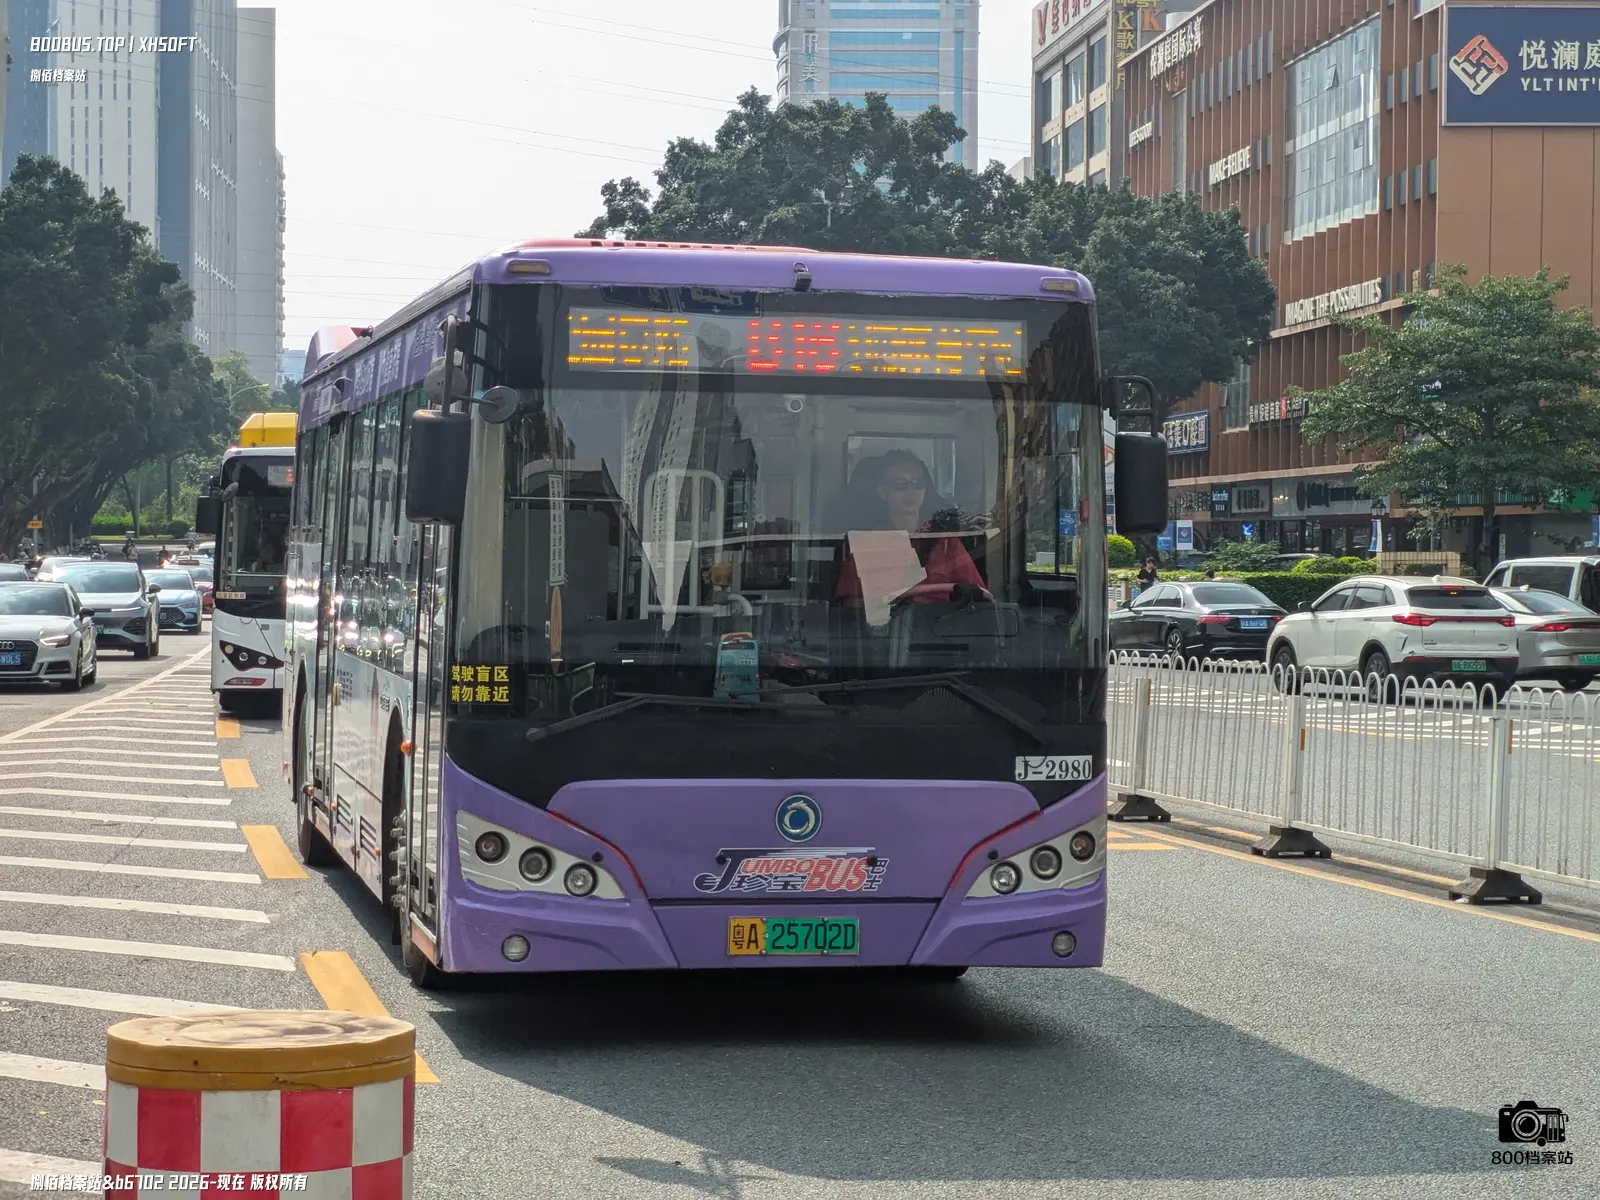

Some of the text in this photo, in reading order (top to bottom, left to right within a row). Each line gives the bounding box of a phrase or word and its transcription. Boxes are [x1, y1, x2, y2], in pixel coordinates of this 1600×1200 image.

[1520, 77, 1600, 92] YLT INT'
[1285, 277, 1382, 326] IMAGINE THE POSSIBILITIES
[451, 665, 510, 683] 驾驶盲区
[451, 685, 510, 703] 请勿靠近
[1017, 759, 1092, 780] J-2980
[804, 857, 870, 892] BUS
